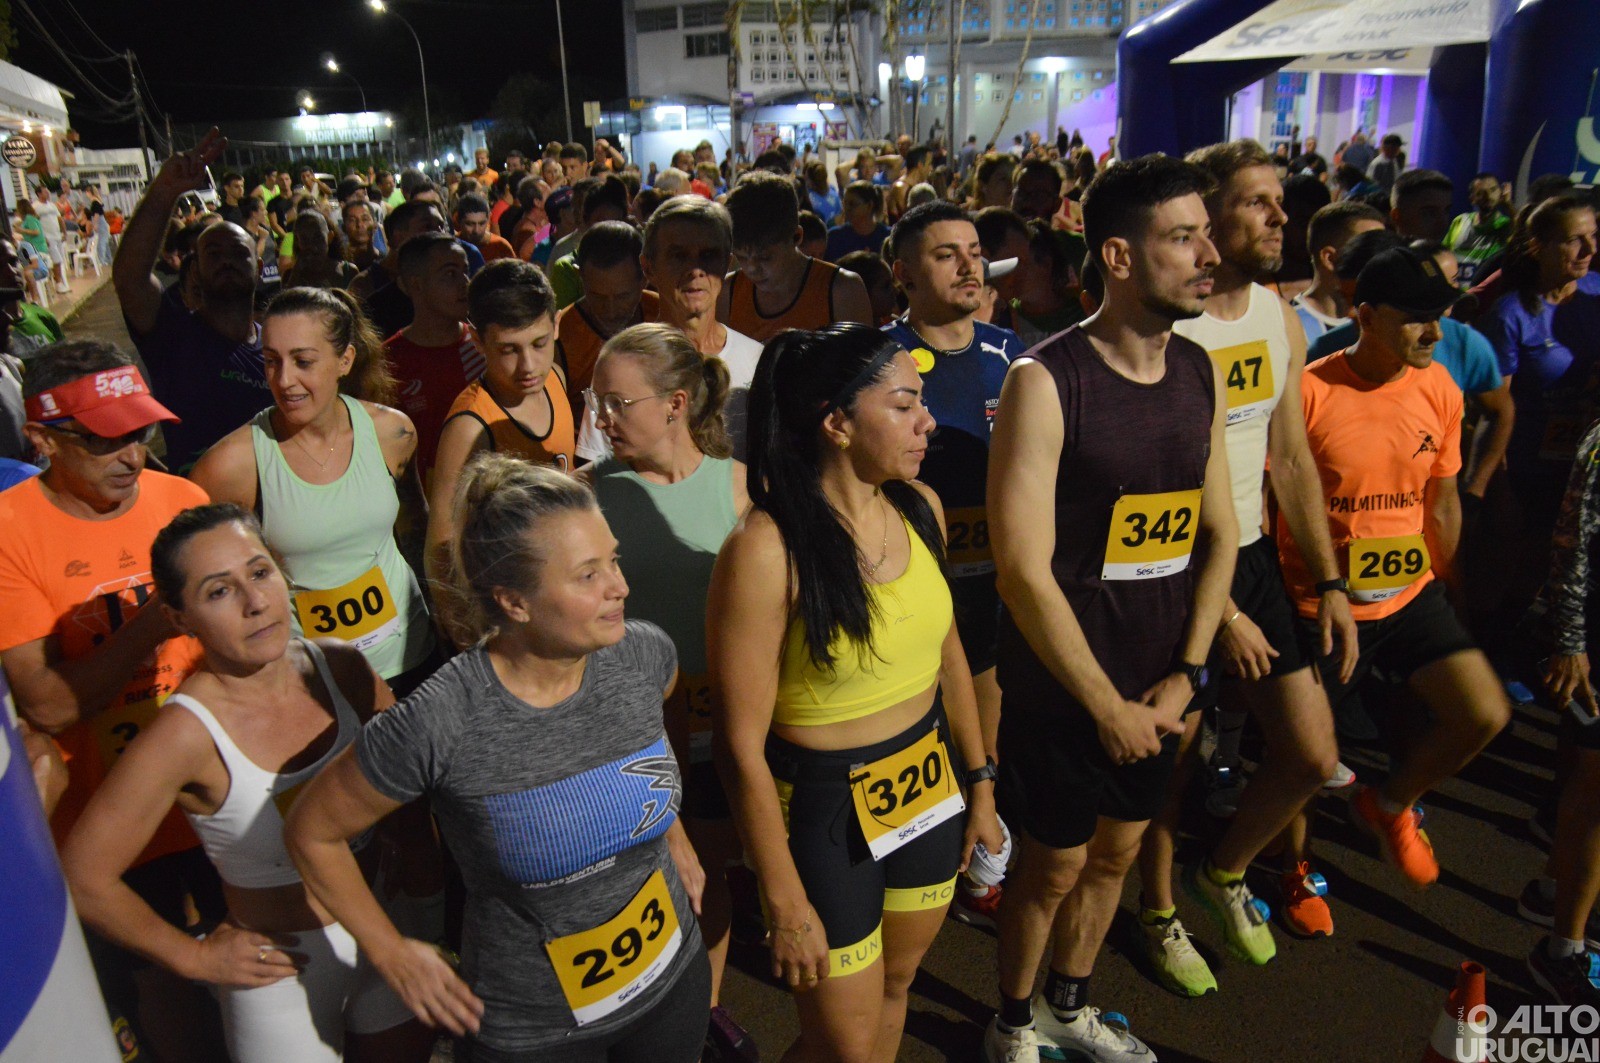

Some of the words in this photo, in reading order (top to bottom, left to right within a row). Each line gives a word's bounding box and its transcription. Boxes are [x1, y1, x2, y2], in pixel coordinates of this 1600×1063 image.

[1227, 356, 1263, 391] 47
[1121, 507, 1192, 548] 342
[1359, 548, 1424, 578] 269
[310, 585, 385, 634] 300
[867, 750, 942, 817] 320
[572, 898, 665, 990] 293
[840, 937, 879, 968] RUN
